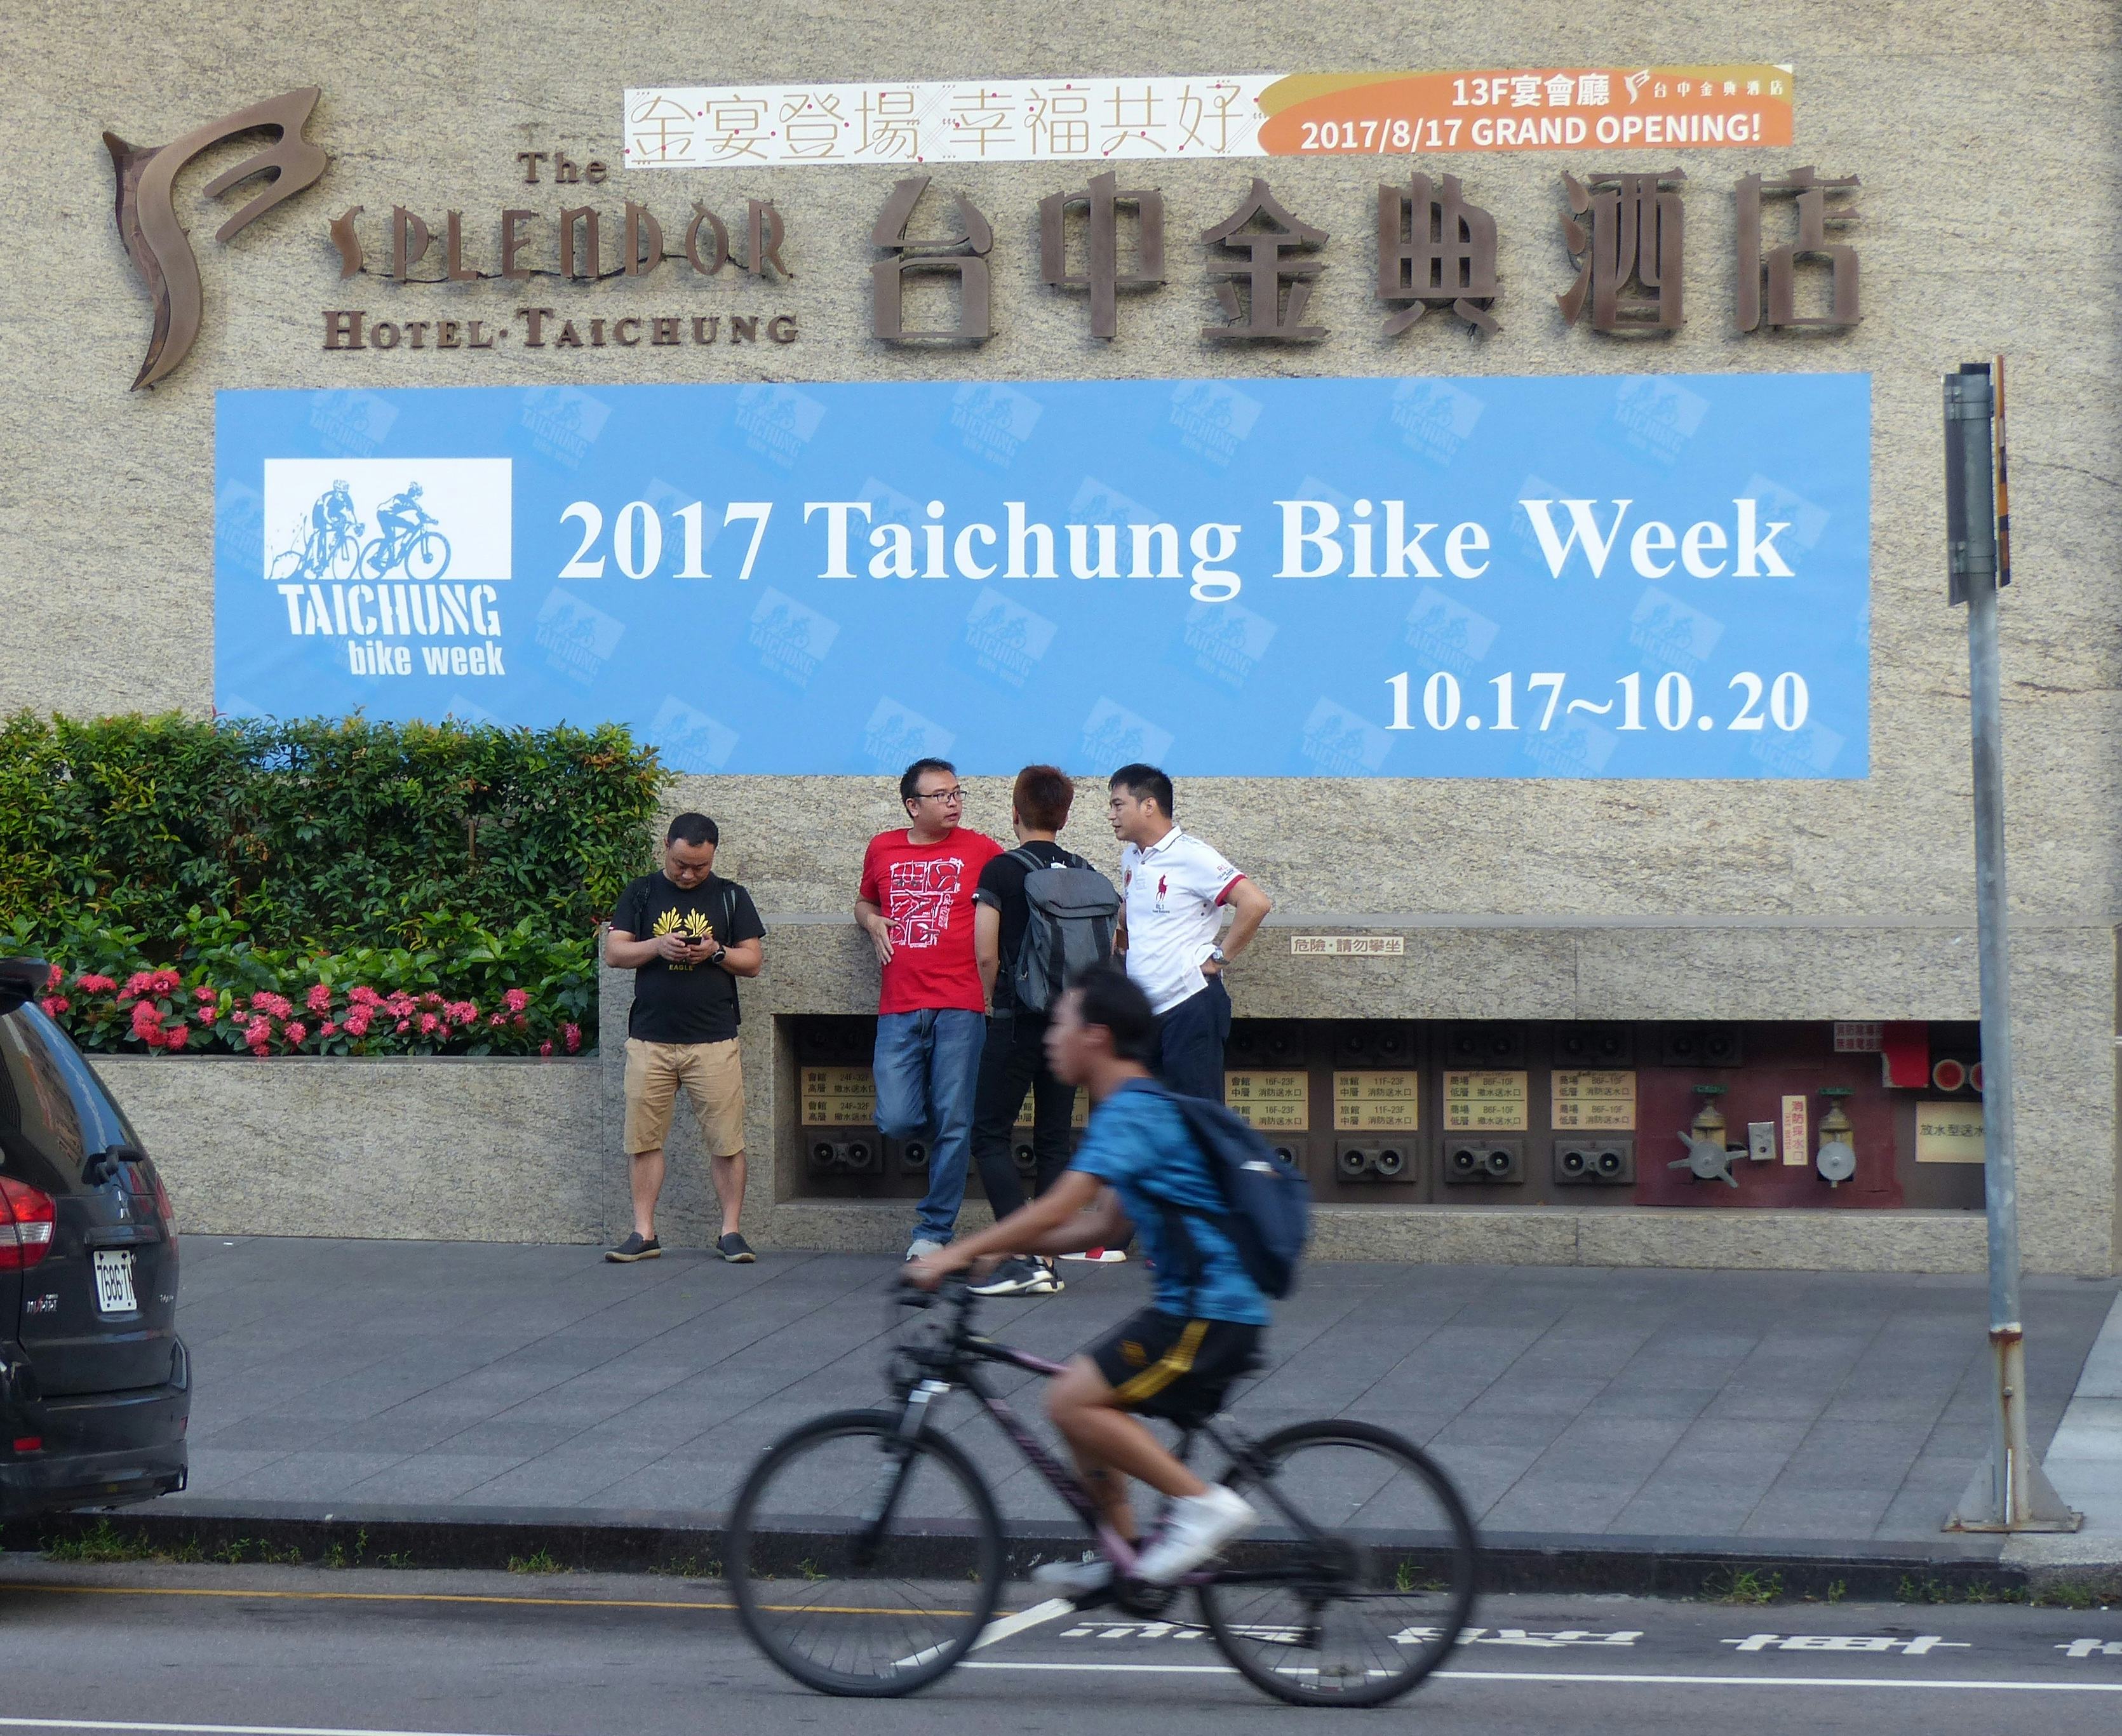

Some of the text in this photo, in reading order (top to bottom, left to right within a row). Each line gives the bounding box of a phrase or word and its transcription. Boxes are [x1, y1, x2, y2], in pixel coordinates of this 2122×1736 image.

[1451, 74, 1611, 108] 13F宴會廳
[631, 84, 1244, 163] 金宴登場 幸福共好
[1300, 112, 1762, 154] 2017/8/17 GRAND OPENING!
[518, 150, 608, 184] The
[328, 198, 793, 282] SPLENDOR
[870, 166, 1860, 340] 台中金典酒店
[557, 501, 773, 581] 2017
[803, 499, 1242, 603] Taichung
[1272, 498, 1491, 580] Bike
[1518, 498, 1796, 580] Week
[278, 584, 502, 637] TAICHUNG
[349, 640, 507, 676] bike week
[1232, 1087, 1302, 1097] 中層 消防送水口
[1340, 1087, 1411, 1097] 中層 消防送水口
[1259, 1117, 1302, 1126] 消防送水口
[1341, 1116, 1411, 1126] 中層 消防送水口
